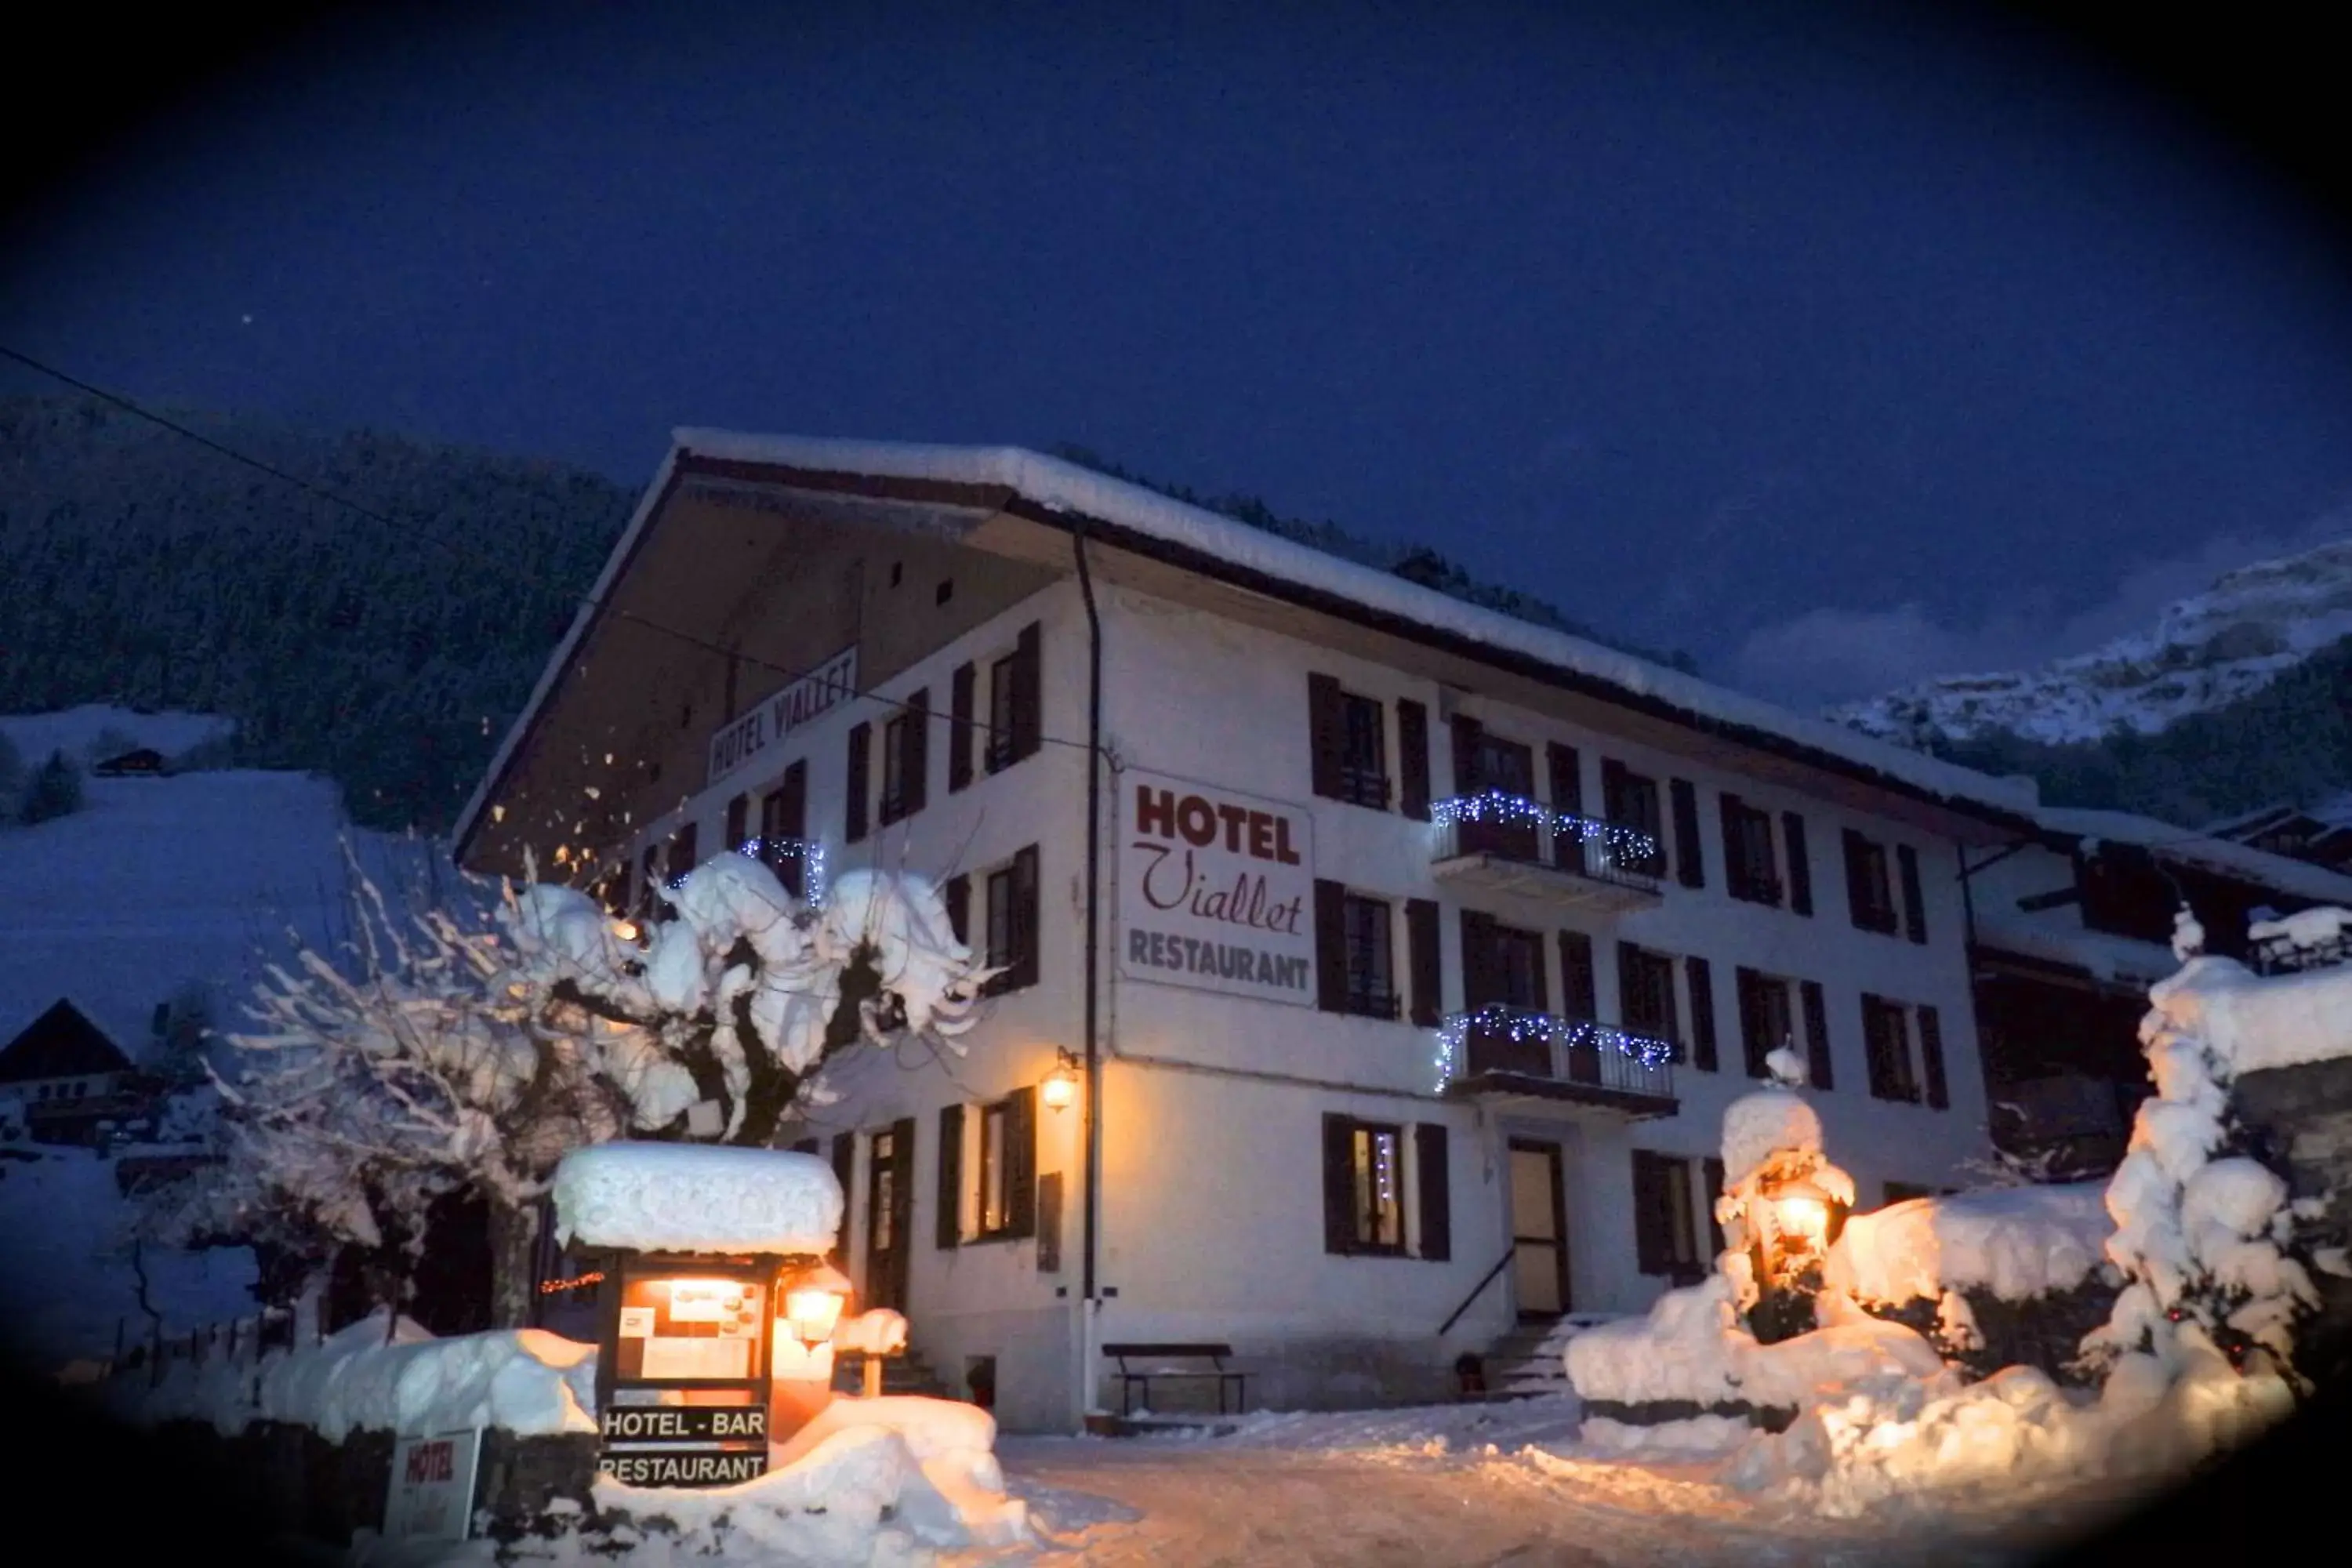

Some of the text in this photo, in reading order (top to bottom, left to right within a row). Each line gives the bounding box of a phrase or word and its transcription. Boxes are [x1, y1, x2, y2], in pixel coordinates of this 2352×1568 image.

[713, 656, 853, 776] HOTEL VIALLET
[1137, 785, 1300, 866] HOTEL
[1131, 841, 1302, 936] Viallet
[1129, 928, 1309, 991] RESTAURANT
[603, 1412, 690, 1436] HOTEL
[712, 1412, 765, 1436] BAR
[406, 1439, 454, 1483] HOTEL
